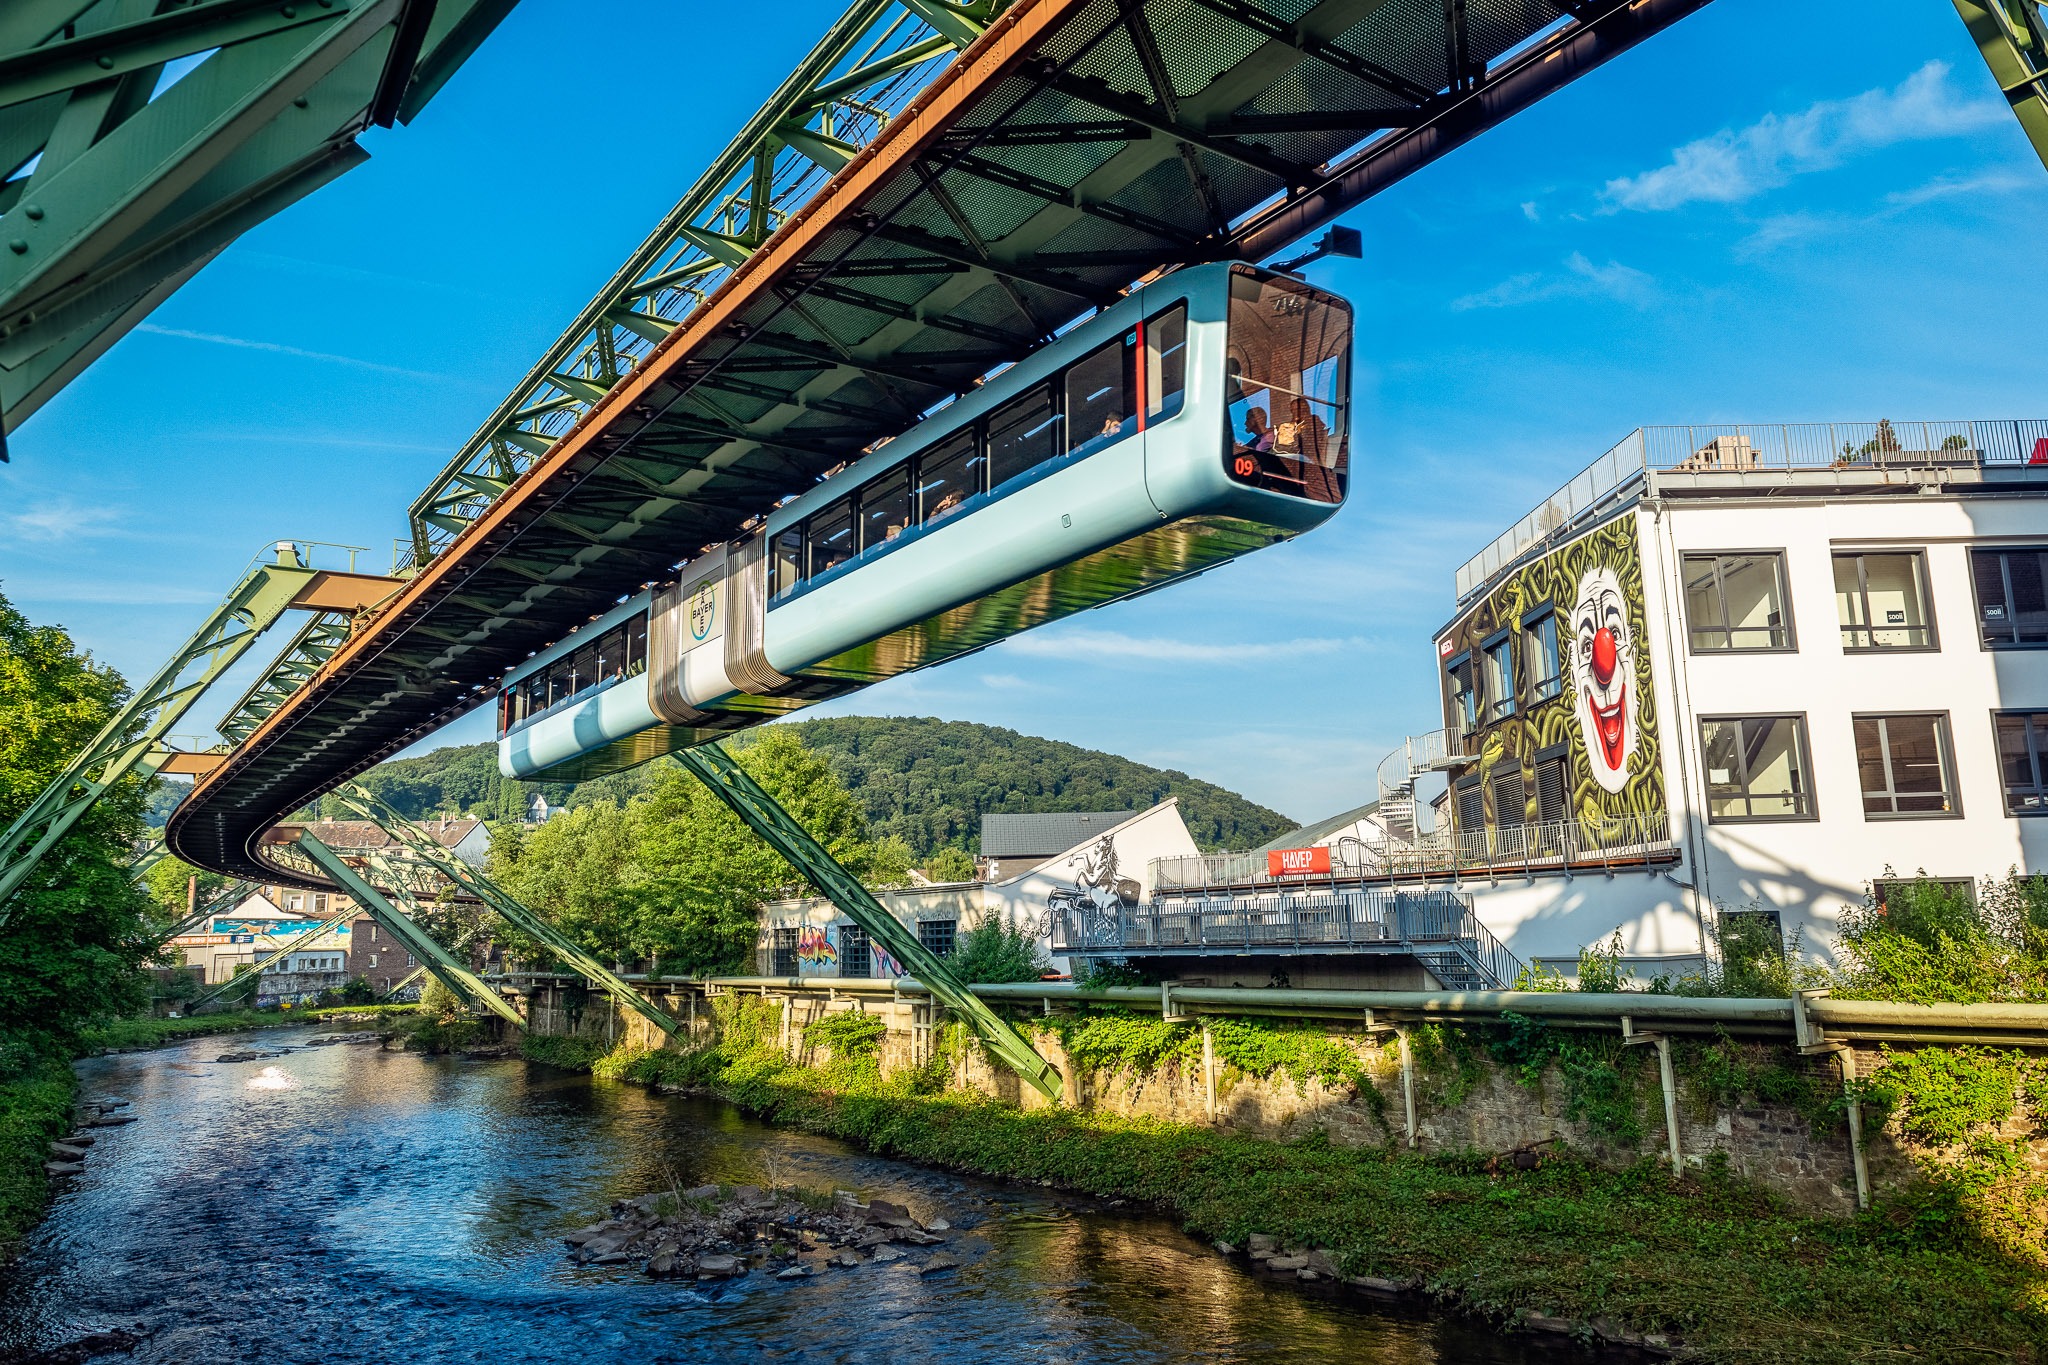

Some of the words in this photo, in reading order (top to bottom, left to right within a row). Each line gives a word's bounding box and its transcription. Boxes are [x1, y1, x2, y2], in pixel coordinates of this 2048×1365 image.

[1235, 458, 1253, 476] 09
[692, 601, 713, 619] BAYER
[1282, 851, 1313, 868] HAVEP
